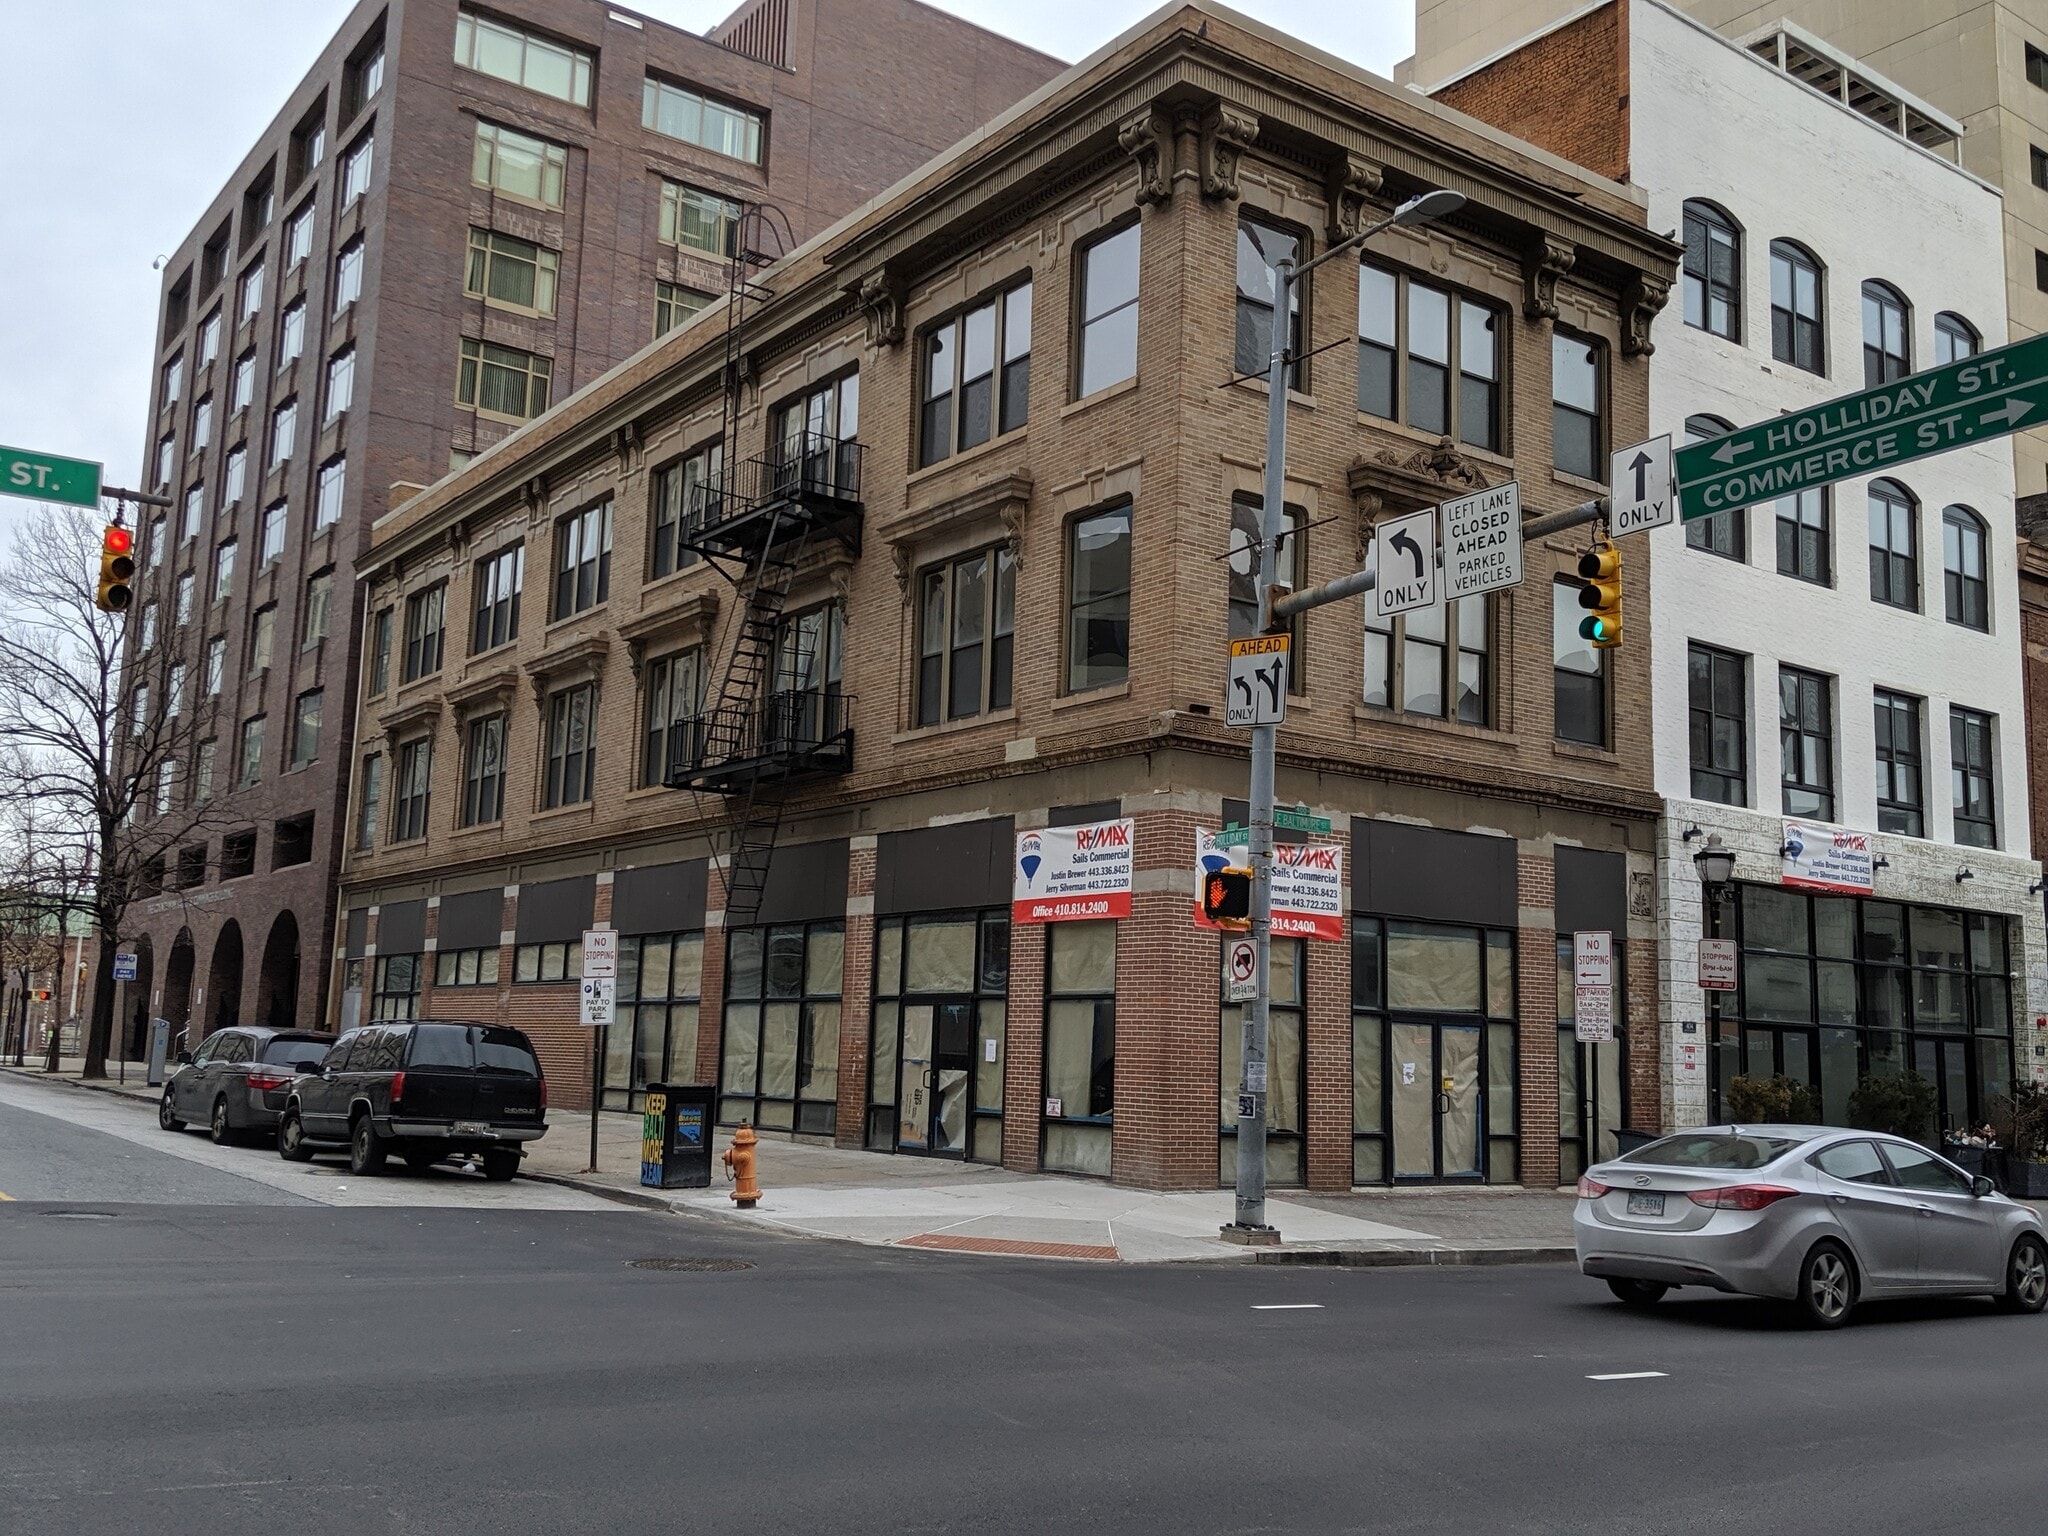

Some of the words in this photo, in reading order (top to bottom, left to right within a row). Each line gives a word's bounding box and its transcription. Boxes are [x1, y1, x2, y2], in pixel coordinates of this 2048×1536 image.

[1767, 379, 1938, 452] HOLLIDAY
[1957, 358, 2017, 394] ST.
[1703, 433, 1899, 507] COMMERCE
[1916, 413, 1974, 448] ST.
[10, 461, 60, 491] ST.
[1448, 500, 1475, 522] LEFT
[1481, 490, 1512, 514] LANE
[1619, 501, 1664, 530] ONLY
[1452, 510, 1510, 539] CLOSED
[1456, 531, 1508, 556] AHEAD
[1459, 551, 1506, 575] PARKED
[1454, 566, 1512, 591] VEHICLES
[1383, 580, 1428, 608] ONLY
[1239, 639, 1281, 656] AHEAD
[1229, 708, 1254, 721] ONLY
[1283, 814, 1320, 831] BALTIMORE
[1076, 824, 1130, 851] RE/MAX
[1216, 832, 1242, 847] HOLLIDAY
[1832, 832, 1867, 851] RE/MAX
[1072, 853, 1088, 864] Sails
[1090, 848, 1130, 863] Commercial
[1276, 845, 1338, 871] RE/MAX
[1828, 849, 1841, 858] Sails
[1841, 851, 1870, 863] Commercial
[1051, 870, 1066, 880] Justin
[1067, 869, 1086, 878] Brewer
[1088, 864, 1130, 877] 443.336.8423
[1812, 859, 1825, 868] Justin
[1825, 861, 1840, 870] Brewer
[1271, 866, 1291, 879] Sails
[1292, 869, 1338, 884] Commercial
[1808, 869, 1819, 878] Jerry
[1045, 884, 1058, 894] Jerry
[1059, 882, 1086, 892] Silverman
[1088, 878, 1129, 890] 443.722.2320
[1271, 884, 1290, 893] rewer
[1291, 885, 1338, 898] 443.336.8423
[1032, 905, 1053, 917] Office
[1054, 901, 1109, 916] 410.814.2400
[1290, 897, 1338, 911] 443.722.2320
[1270, 917, 1316, 933] .814.2400
[594, 938, 606, 947] NO
[1586, 940, 1599, 950] NO
[586, 951, 614, 960] STOPPING
[1578, 955, 1609, 965] STOPPING
[1702, 953, 1733, 961] STOPPING
[1702, 963, 1733, 972] 8PM-6AM
[1587, 988, 1610, 996] PARKING
[645, 1093, 667, 1116] KEEP
[643, 1115, 665, 1140] BALTI
[642, 1139, 664, 1164] MORE
